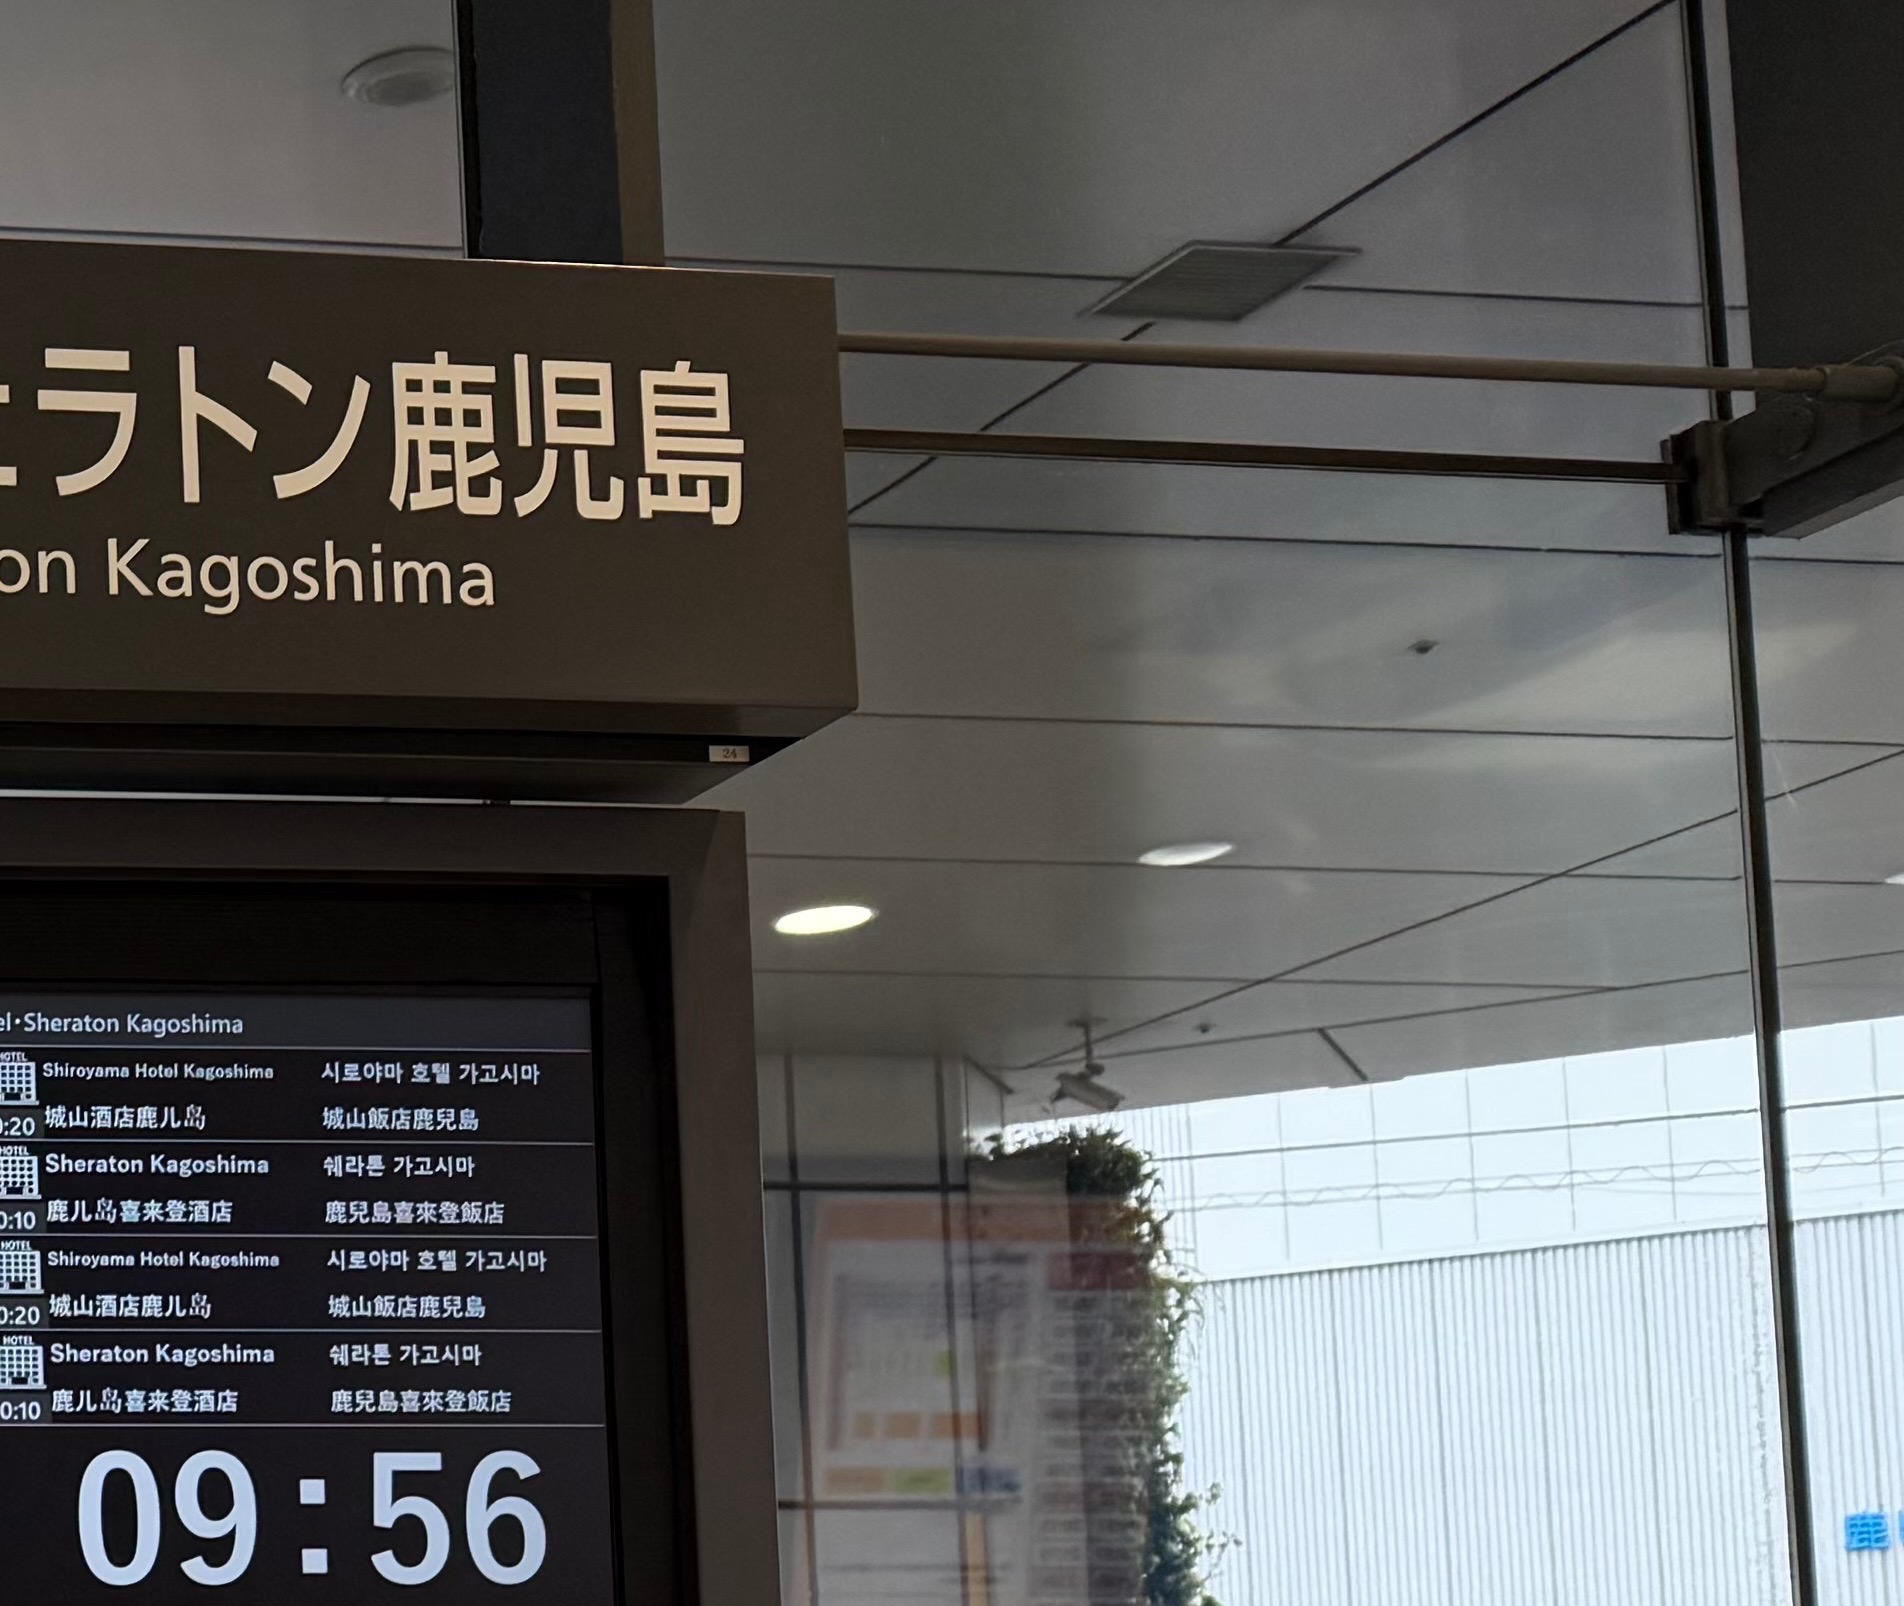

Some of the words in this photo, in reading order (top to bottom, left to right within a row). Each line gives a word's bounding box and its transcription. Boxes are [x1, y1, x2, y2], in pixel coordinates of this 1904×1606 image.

[106, 537, 496, 615] Kagoshima
[126, 1013, 244, 1038] Kagoshima
[42, 1062, 130, 1081] Shiroyama
[135, 1062, 180, 1080] Hotel
[184, 1062, 274, 1081] Kagoshima
[321, 1062, 404, 1085] 시로야마
[410, 1062, 451, 1085] 호텔
[458, 1062, 541, 1086] 가고시마
[45, 1153, 145, 1174] Sheraton
[150, 1154, 270, 1178] Kagoshima
[322, 1154, 386, 1178] 쉐라톤
[392, 1155, 476, 1179] 가고시마
[47, 1251, 135, 1271] Shiroyama
[140, 1252, 185, 1269] Hotel
[189, 1252, 280, 1271] Kagoshima
[327, 1249, 410, 1272] 시로야마
[416, 1249, 457, 1272] 호텔
[464, 1249, 547, 1273] 가고시마
[50, 1343, 150, 1364] Sheraton
[155, 1344, 275, 1368] Kagoshima
[329, 1343, 392, 1366] 쉐라톤
[399, 1344, 482, 1368] 가고시마
[0, 1400, 41, 1422] 0:10
